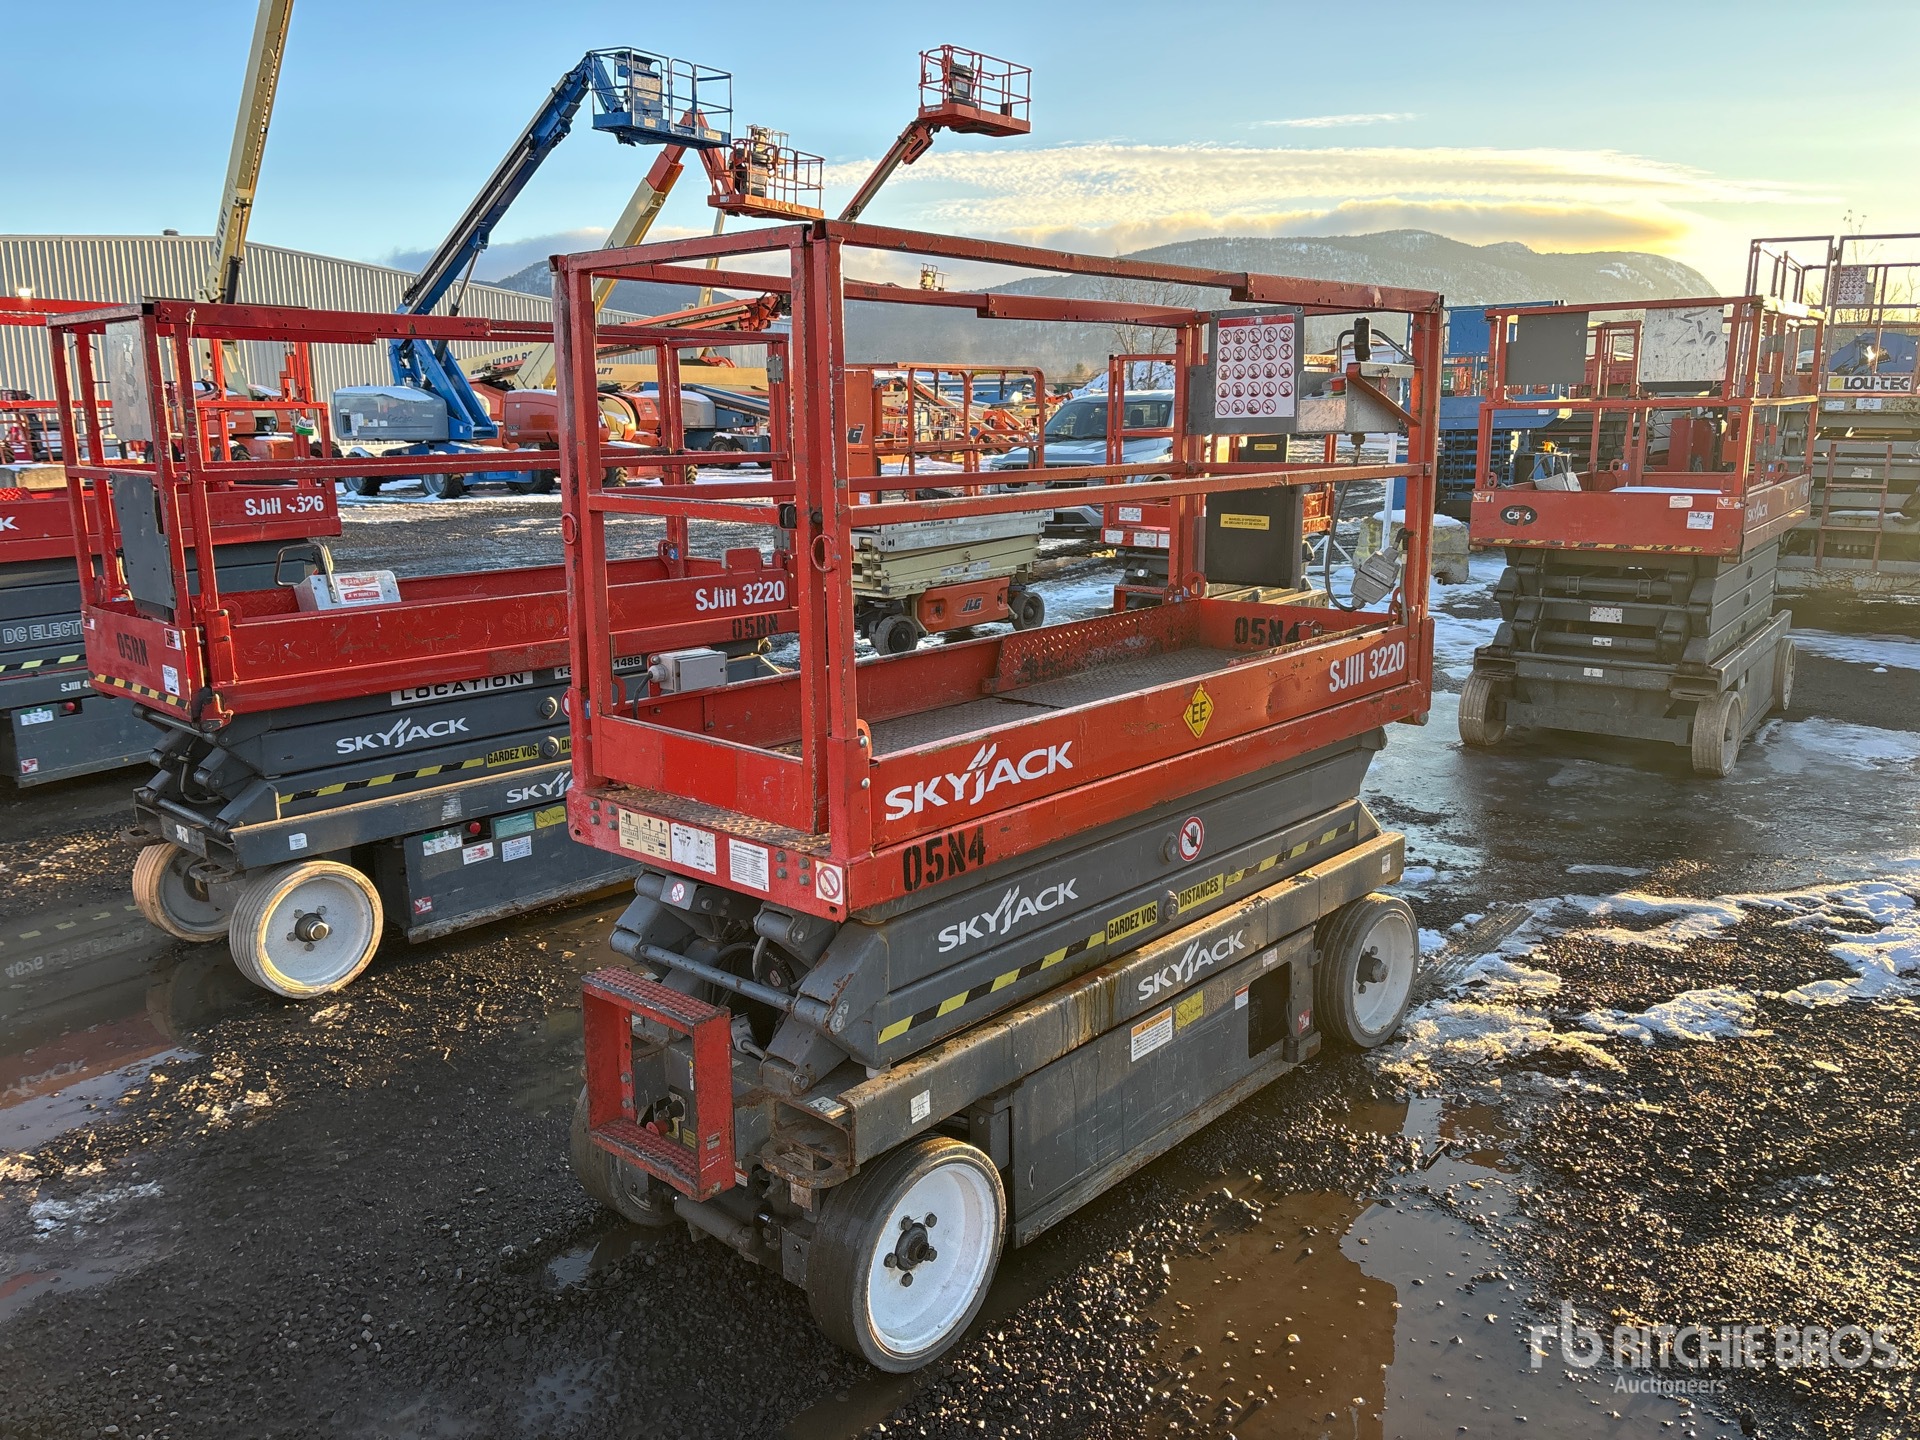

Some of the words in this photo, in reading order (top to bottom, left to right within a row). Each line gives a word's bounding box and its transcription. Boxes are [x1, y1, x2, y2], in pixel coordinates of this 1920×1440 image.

[1506, 511, 1531, 520] C86
[742, 580, 785, 606] 3220
[962, 597, 984, 612] JLG
[3, 627, 28, 644] DC
[400, 672, 524, 701] LOCATION
[614, 656, 640, 668] 1486
[1329, 652, 1365, 693] SJIII
[1369, 641, 1405, 680] 3220
[1191, 700, 1207, 724] EE
[336, 717, 470, 754] SKYJACK
[487, 748, 520, 765] GARDEZ
[521, 745, 538, 759] VOS
[884, 740, 1074, 821] SKYJACK
[902, 824, 986, 892] 05N4
[938, 877, 1079, 953] SKYJACK
[1108, 911, 1140, 940] GARDEZ
[1141, 904, 1157, 925] VOS
[1179, 877, 1219, 908] DISTANCES
[1137, 929, 1246, 1001] SKYJACK
